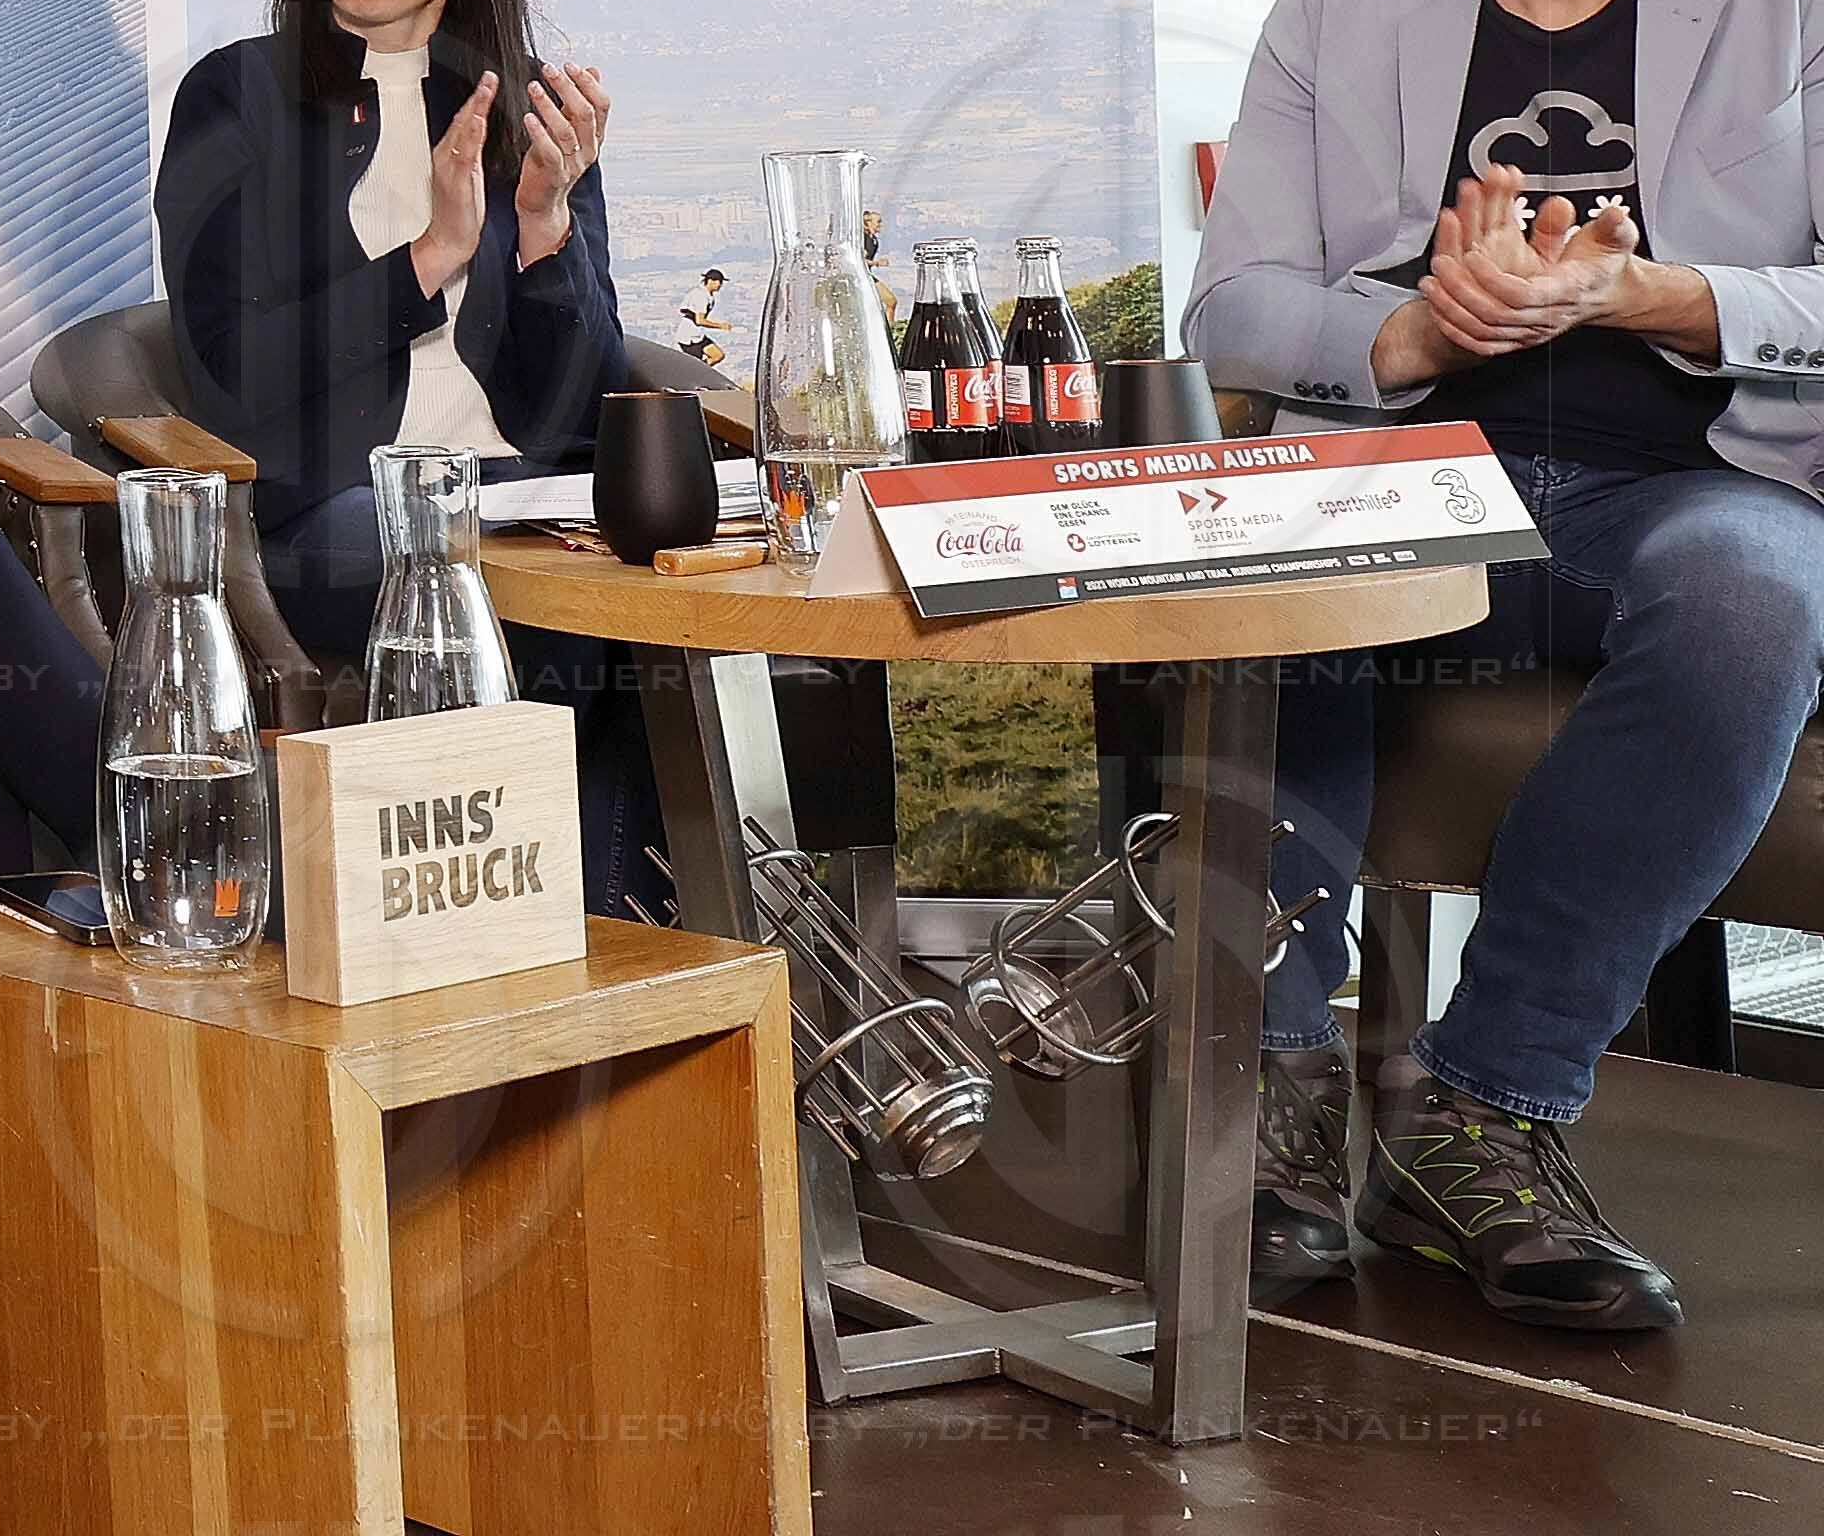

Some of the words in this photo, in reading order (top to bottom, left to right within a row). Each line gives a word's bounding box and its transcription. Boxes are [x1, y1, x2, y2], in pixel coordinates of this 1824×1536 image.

[1054, 458, 1140, 484] SPORTS
[1144, 452, 1218, 476] MEDIA
[1222, 444, 1316, 469] AUSTRIA
[1050, 503, 1069, 512] DEM
[1054, 511, 1074, 520] EINE
[1075, 508, 1111, 518] CHANCE
[1317, 496, 1391, 519] sporthilfe
[1188, 517, 1237, 531] SPORTS
[1242, 513, 1284, 526] MEDIA
[937, 524, 1024, 559] Coca-Cola
[1088, 536, 1142, 548] LOTTERIEN
[1193, 530, 1248, 543] AUSTRIA
[381, 841, 543, 922] BRUCK
